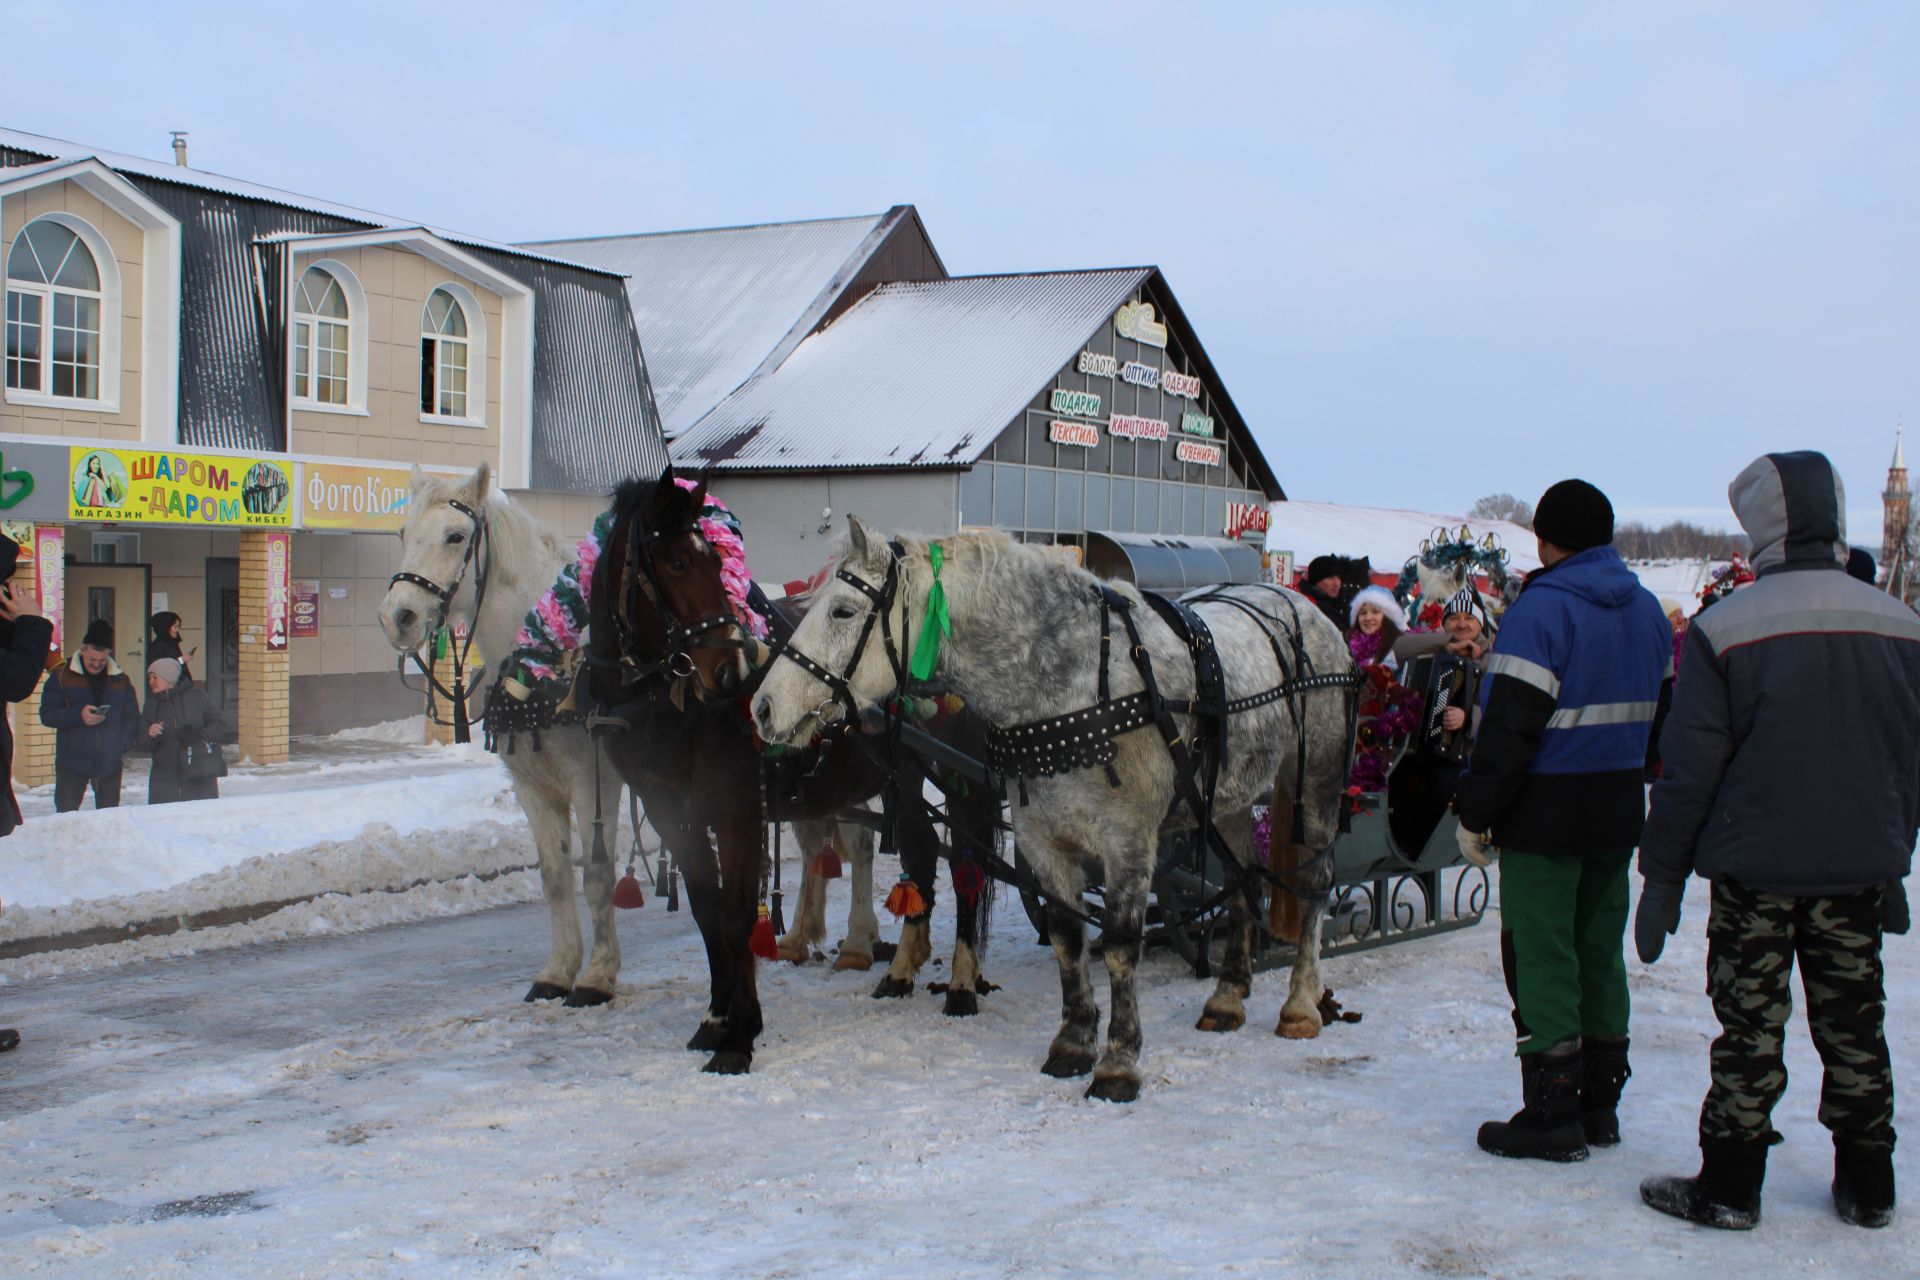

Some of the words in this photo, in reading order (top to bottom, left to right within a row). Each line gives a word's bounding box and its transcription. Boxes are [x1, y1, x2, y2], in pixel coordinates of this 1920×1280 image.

[1080, 353, 1116, 375] ЗОЛОТО
[1124, 363, 1159, 387] ОПТИКА
[1164, 376, 1200, 398] ОДЕЖДА
[1053, 391, 1100, 413] ПОДАРКИ
[1052, 422, 1098, 444] ТЕКСТИЛЬ
[1110, 416, 1168, 440] КАНЦТОВАРЫ
[1184, 415, 1214, 435] ПОСУДА
[1178, 442, 1219, 464] СУВЕНИРЫ
[132, 456, 238, 492] ШАРОМ-
[308, 471, 412, 515] ФотоКоп
[74, 508, 142, 519] МАГАЗИН
[246, 515, 286, 524] КИБЕТ
[1227, 502, 1269, 541] Цветы
[271, 540, 287, 633] ОДЕЖДА
